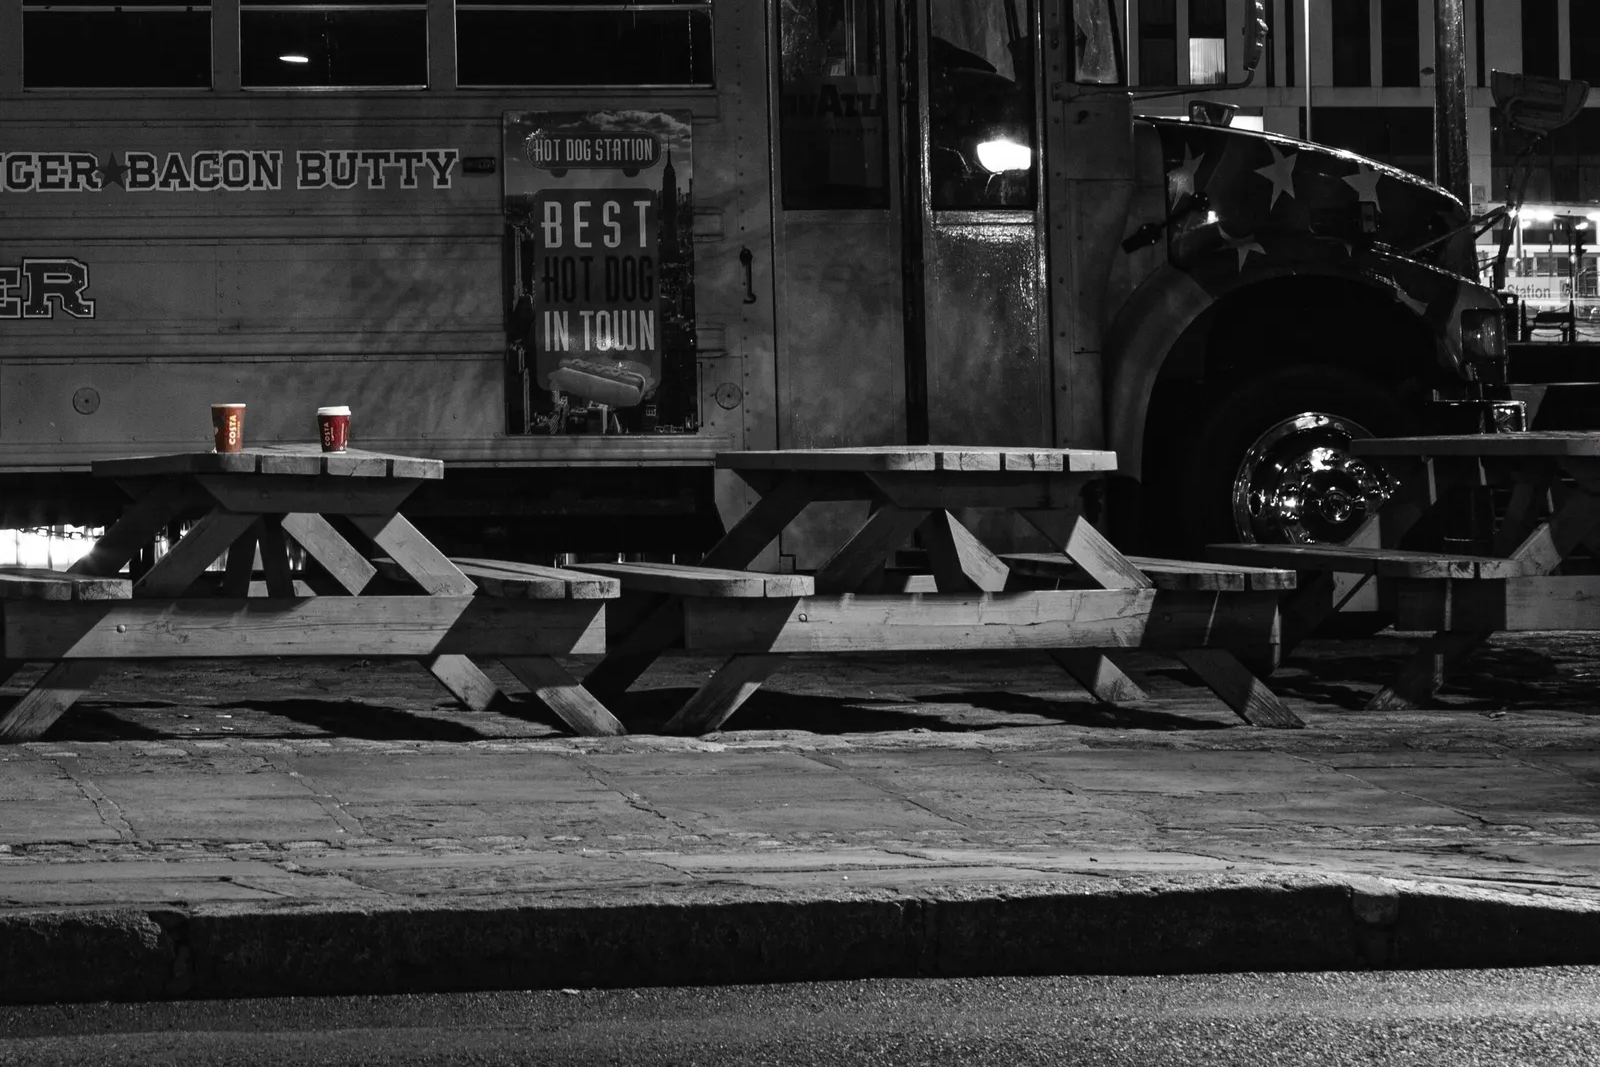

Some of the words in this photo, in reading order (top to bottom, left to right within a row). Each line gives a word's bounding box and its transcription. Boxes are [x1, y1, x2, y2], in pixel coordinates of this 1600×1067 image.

[534, 138, 561, 162] HOT
[566, 138, 592, 162] DOG
[595, 138, 653, 162] STATION
[124, 150, 283, 192] BACON
[296, 149, 459, 190] BUTTY
[541, 200, 651, 249] BEST
[542, 255, 594, 304] HOT
[605, 255, 654, 303] DOG
[1506, 284, 1551, 299] Station
[544, 310, 569, 352] IN
[579, 309, 655, 352] TOWN
[228, 414, 237, 445] COSTA
[323, 421, 331, 446] COSTA
